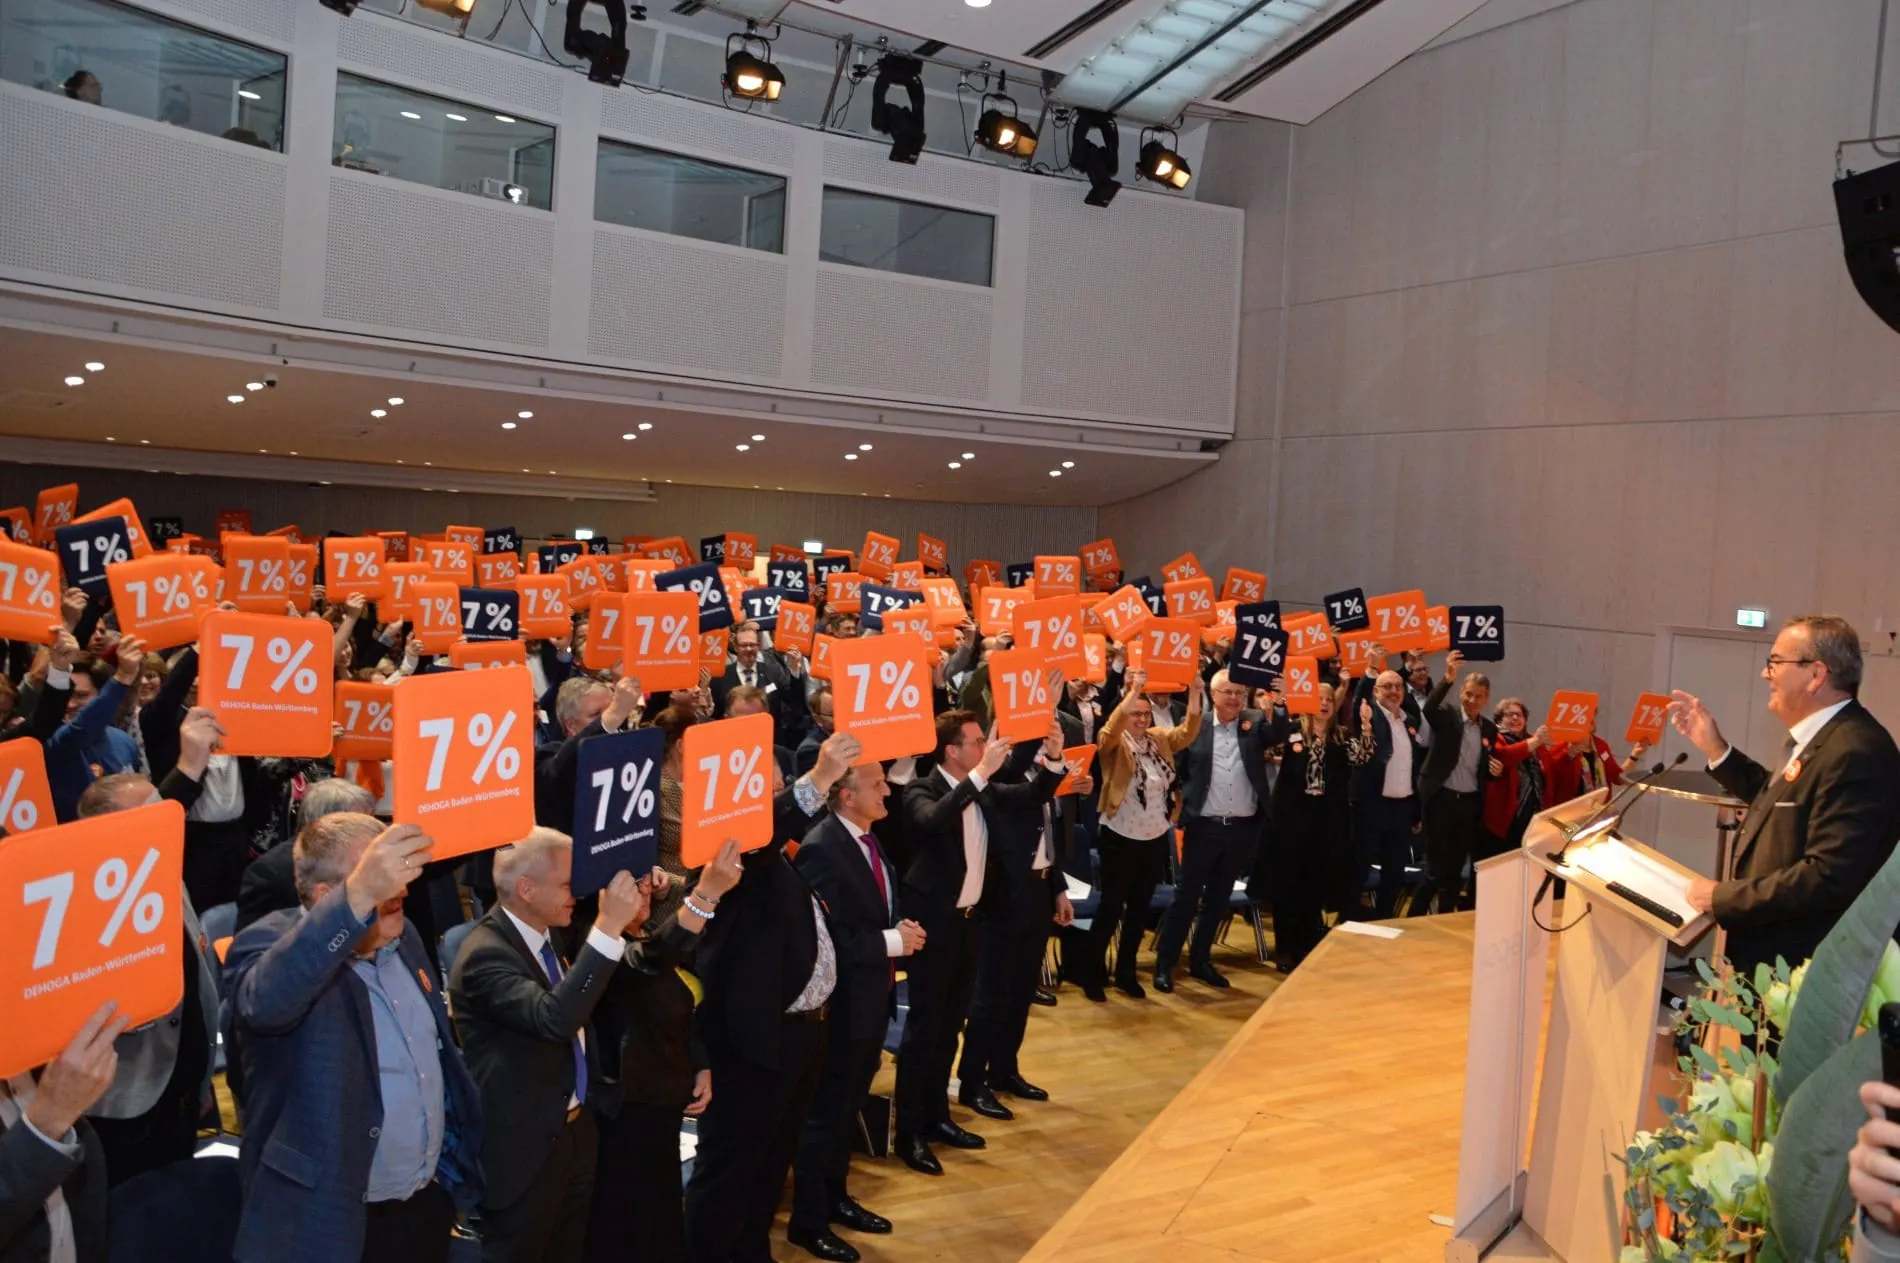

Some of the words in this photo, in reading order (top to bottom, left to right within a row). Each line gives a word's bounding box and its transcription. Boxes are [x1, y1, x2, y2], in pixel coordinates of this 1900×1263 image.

[237, 559, 285, 592] 7%
[462, 601, 512, 632] 7%
[636, 615, 691, 655] 7%
[1024, 615, 1077, 650] 7%
[1376, 604, 1420, 632] 7%
[1456, 615, 1498, 638] 7%
[221, 633, 318, 694] 7%
[1150, 630, 1192, 659] 7%
[1243, 634, 1282, 666] 7%
[847, 660, 920, 713] 7%
[1002, 668, 1047, 710] 7%
[419, 710, 521, 792] 7%
[591, 757, 655, 833] 7%
[698, 745, 765, 811] 7%
[23, 847, 165, 971] 7%
[24, 975, 71, 1001] DEHOGA
[72, 943, 166, 984] Baden-Württemberg
